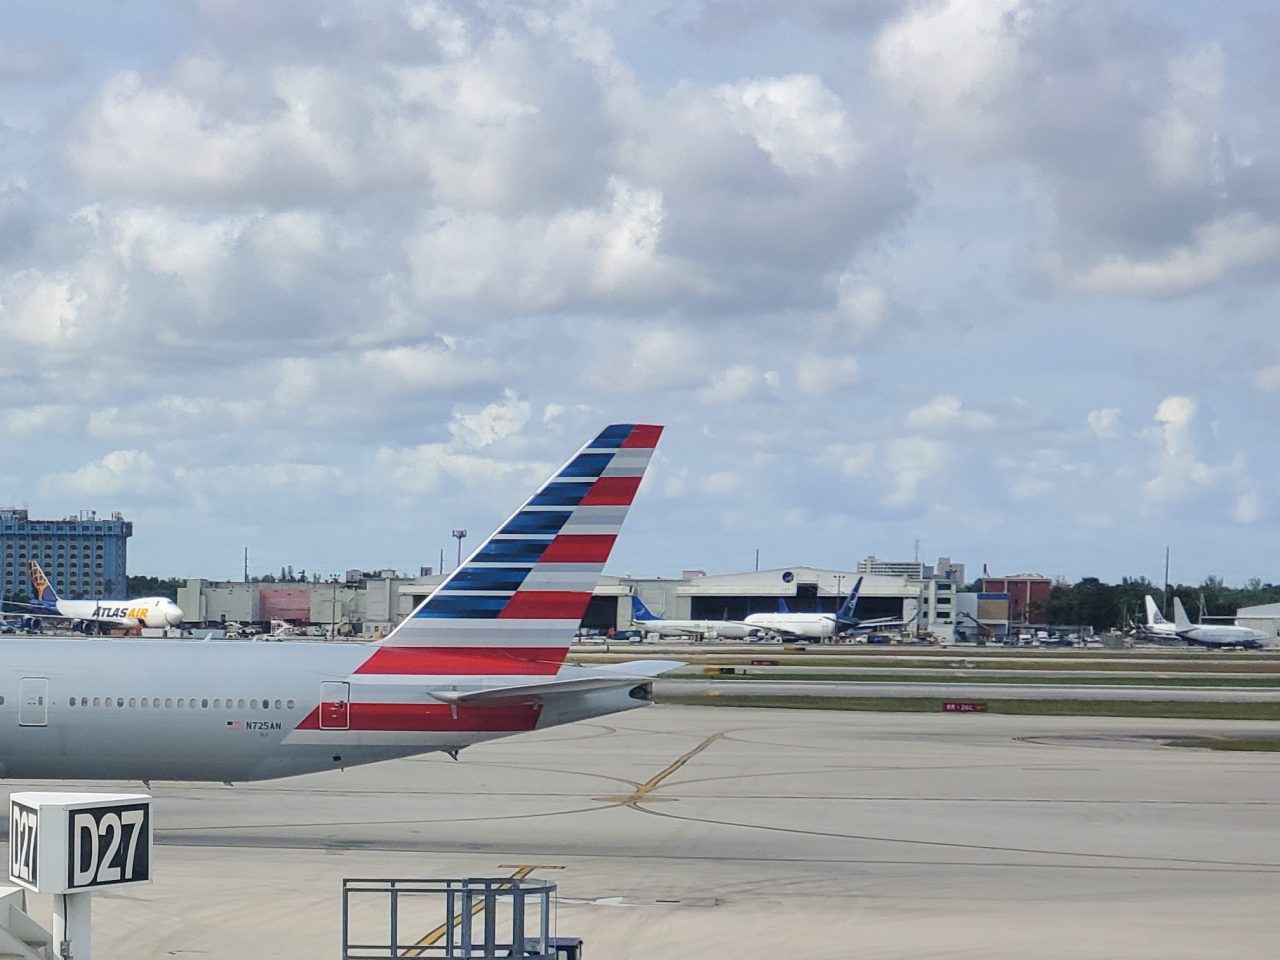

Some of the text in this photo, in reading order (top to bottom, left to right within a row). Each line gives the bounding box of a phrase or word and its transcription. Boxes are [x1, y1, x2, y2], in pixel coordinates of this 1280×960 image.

[91, 606, 149, 618] ATLAS AIR
[246, 721, 282, 730] N725AN
[12, 804, 37, 883] D27
[73, 810, 145, 887] D27
